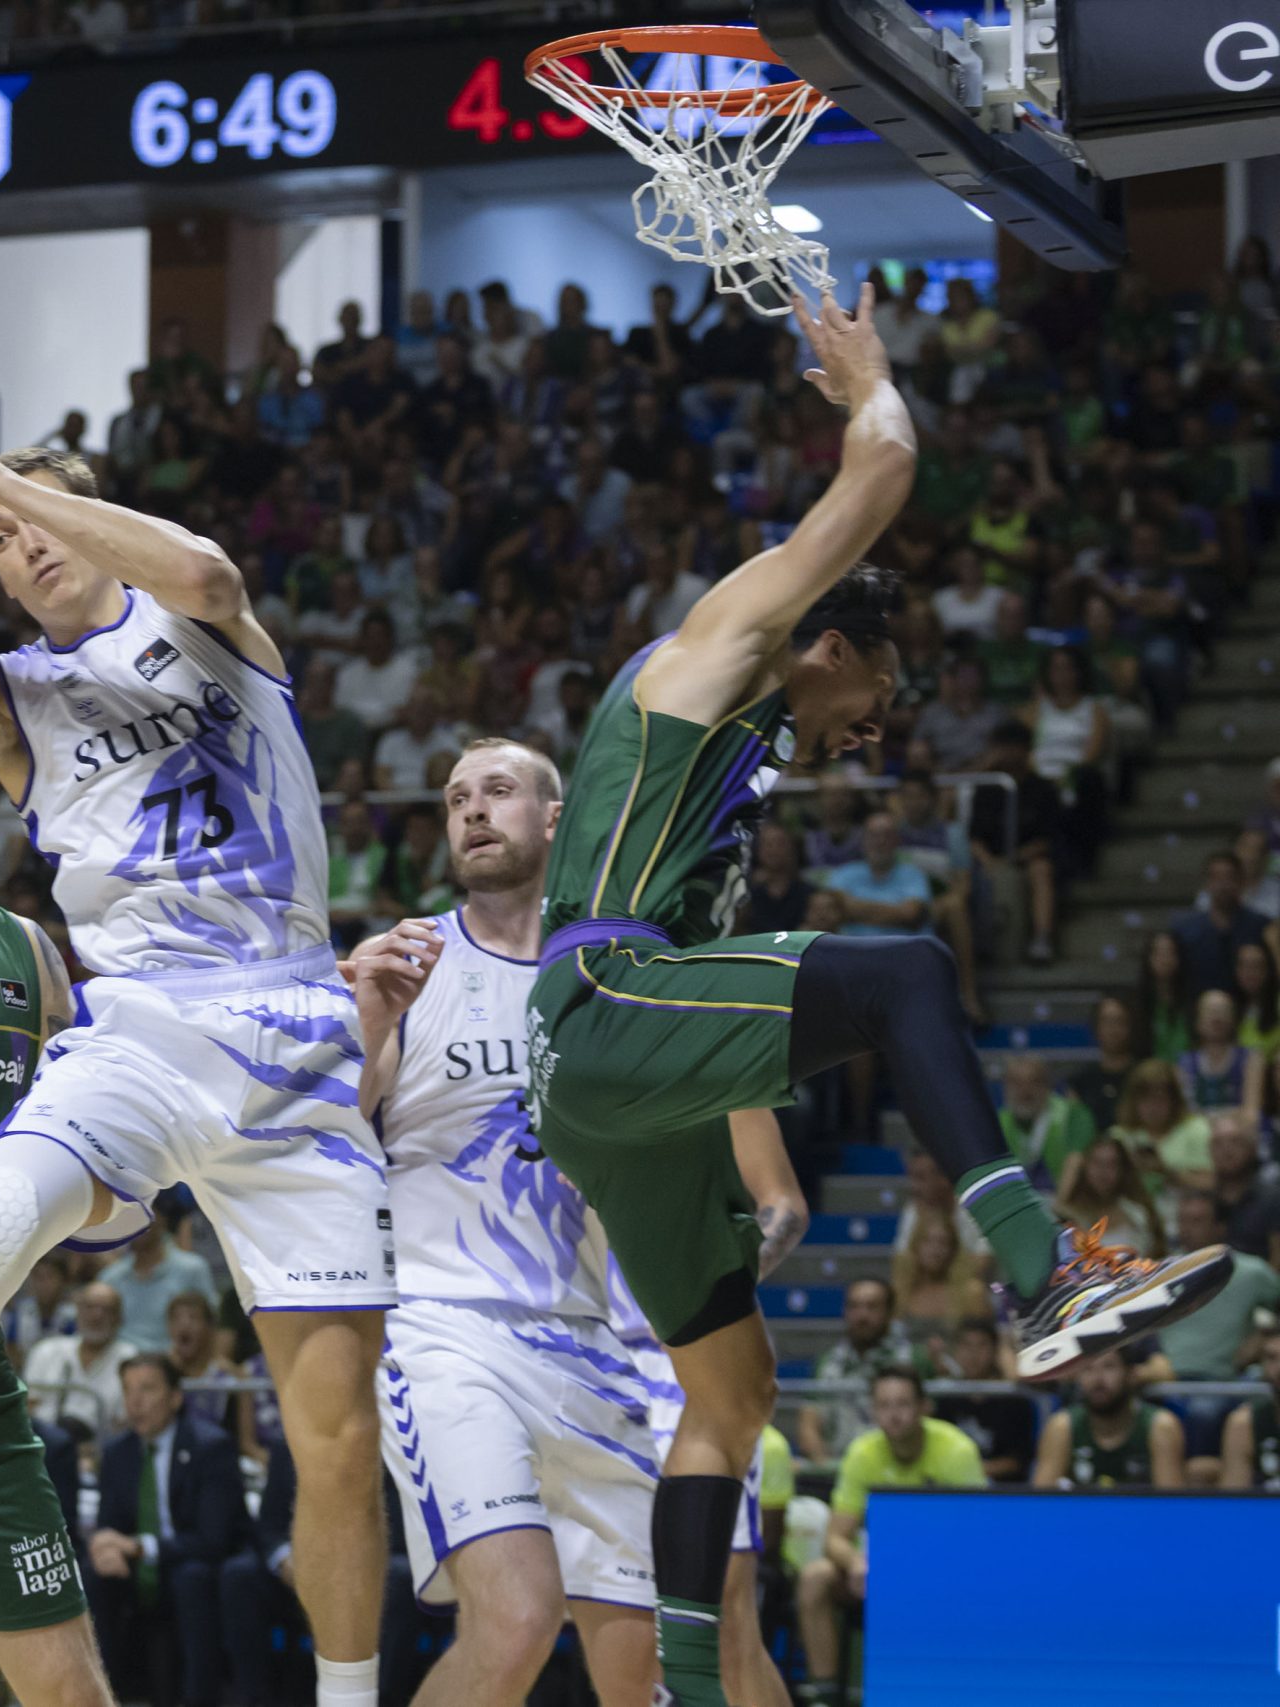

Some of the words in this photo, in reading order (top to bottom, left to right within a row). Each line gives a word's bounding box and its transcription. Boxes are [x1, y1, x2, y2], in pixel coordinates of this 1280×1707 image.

[130, 69, 338, 168] 6:49
[141, 774, 235, 862] 73
[445, 1038, 530, 1081] su
[287, 1269, 369, 1282] NISSAN
[483, 1499, 501, 1510] EL
[10, 1532, 49, 1555] sabor
[13, 1556, 23, 1569] a
[22, 1531, 67, 1573] má
[16, 1562, 72, 1597] laga
